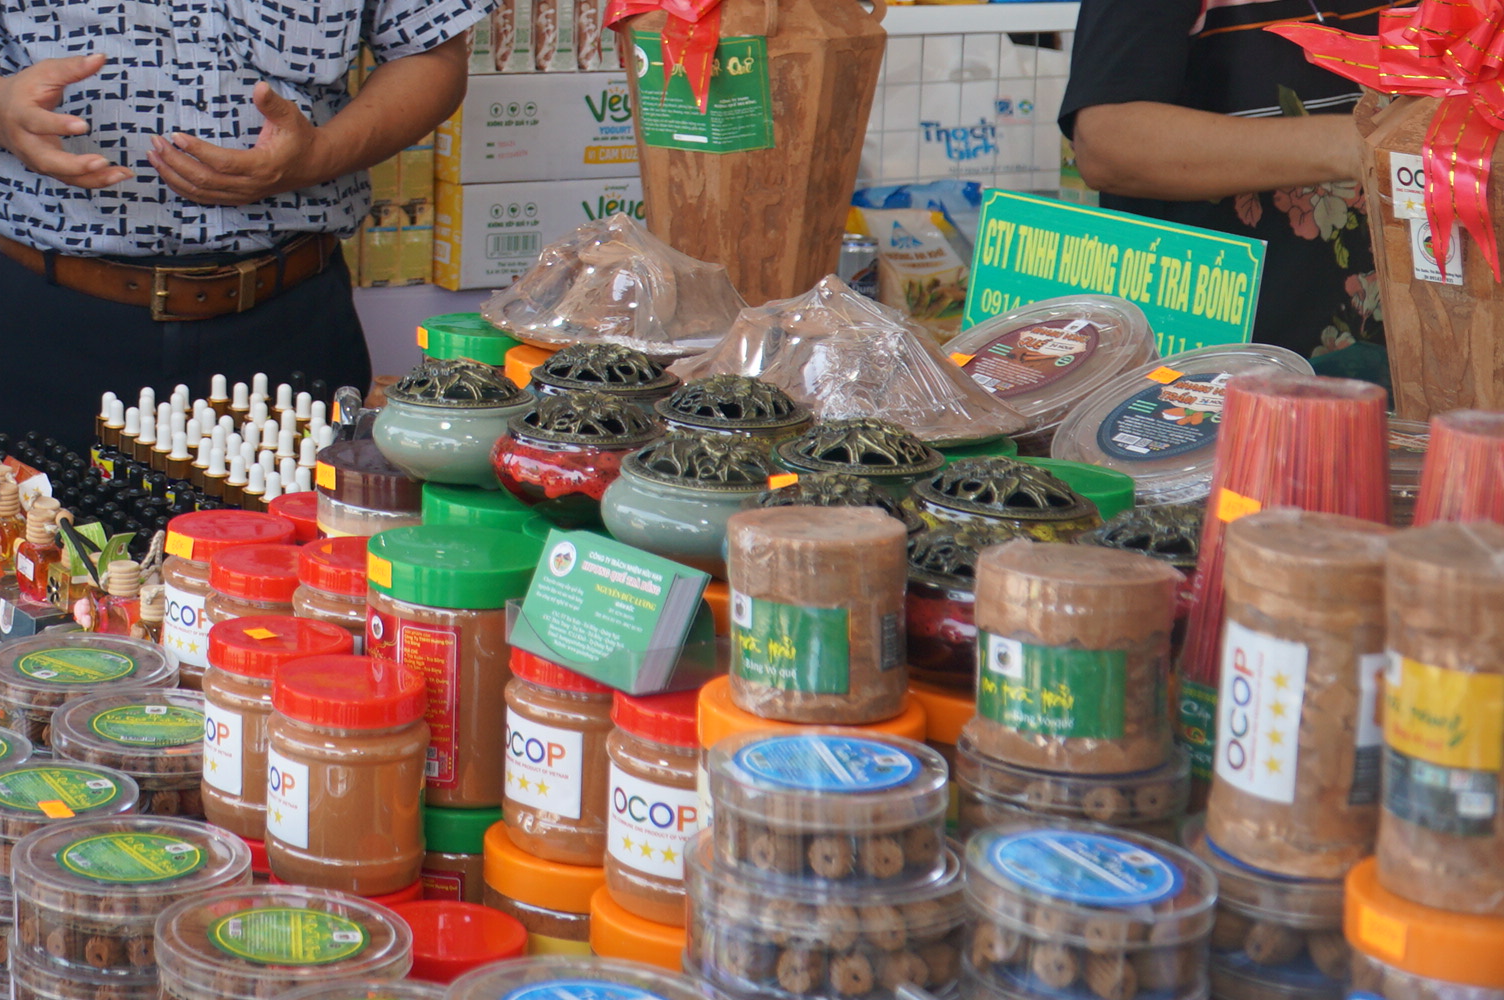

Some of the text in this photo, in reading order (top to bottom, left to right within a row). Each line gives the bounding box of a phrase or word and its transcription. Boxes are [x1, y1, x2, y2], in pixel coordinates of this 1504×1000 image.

[584, 89, 633, 124] Vey
[620, 146, 640, 160] YUZ
[1397, 166, 1425, 189] OC
[982, 218, 1016, 270] CTY
[1014, 225, 1060, 280] TNHH
[1058, 233, 1119, 294] HƯƠNG
[1118, 237, 1162, 304] QUẾ
[1157, 250, 1192, 313] TRÀ
[1227, 647, 1255, 771] OCOP
[206, 717, 230, 746] OP
[270, 766, 296, 797] OP
[613, 786, 698, 833] OCOP
